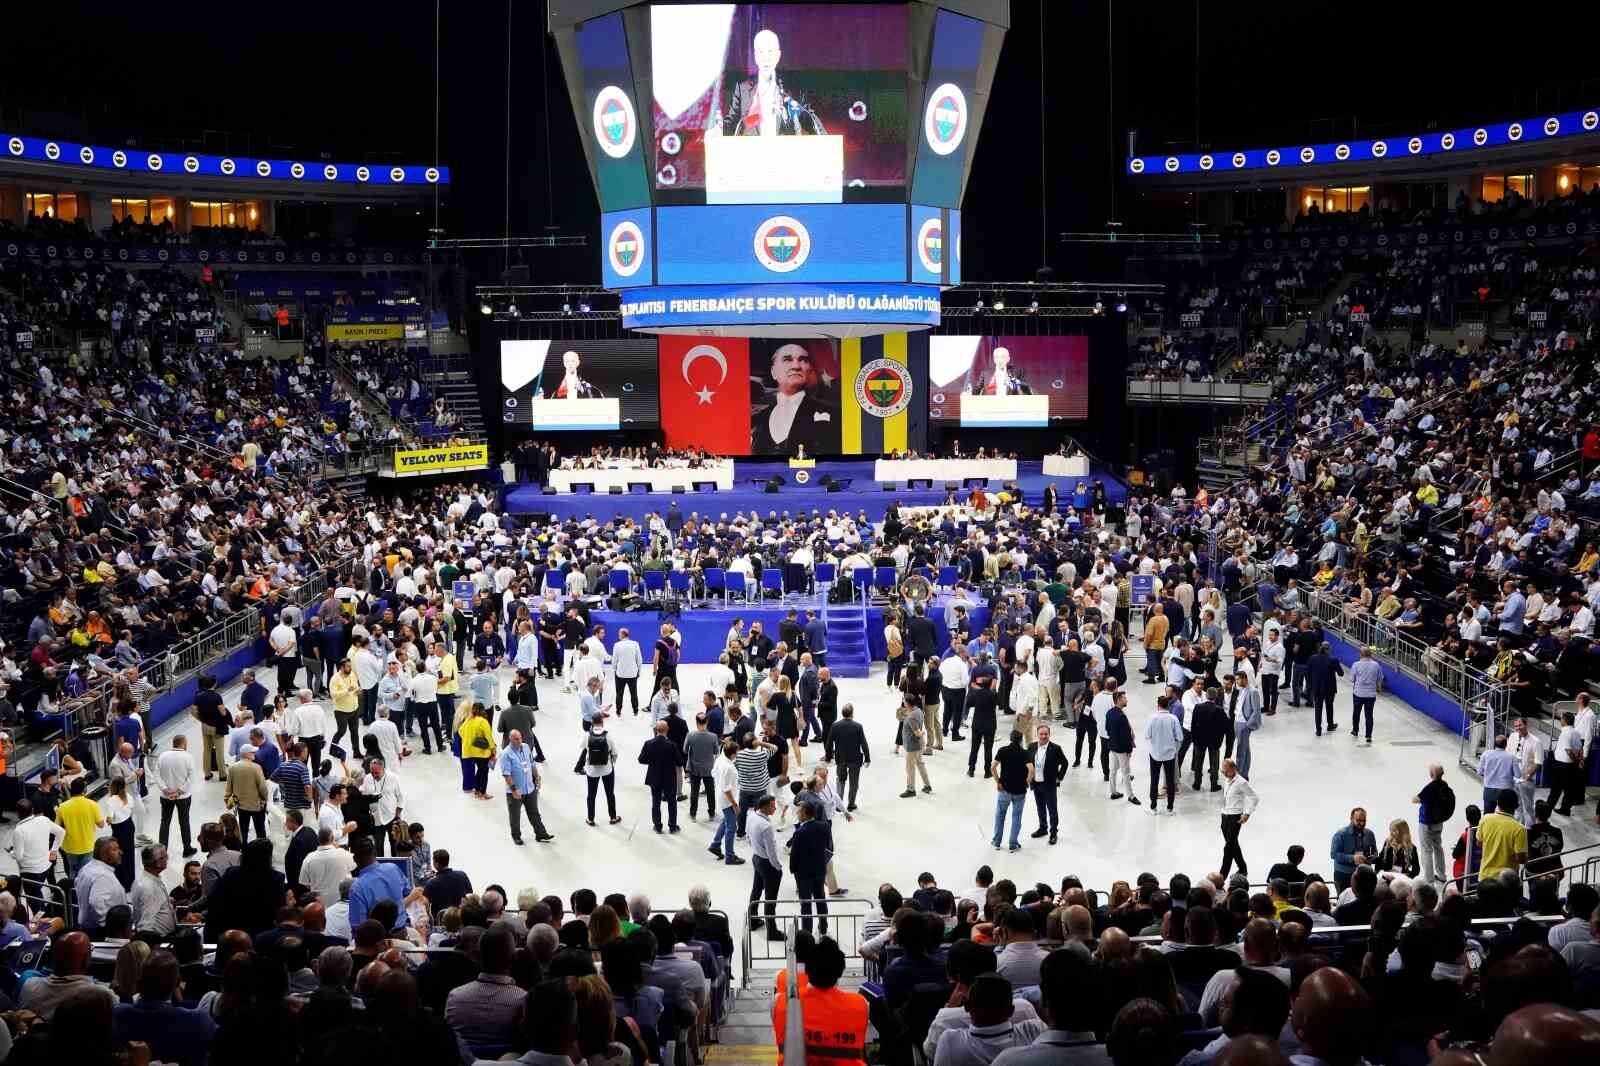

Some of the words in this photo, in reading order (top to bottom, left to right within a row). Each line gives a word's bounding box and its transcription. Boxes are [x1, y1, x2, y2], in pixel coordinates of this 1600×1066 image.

[670, 298, 754, 313] FENERBAHÇE
[756, 297, 796, 311] SPOR
[800, 294, 855, 310] KULÜBÜ
[858, 294, 923, 312] OLAĞANÜSTÜ
[401, 453, 447, 466] YELLOW
[449, 450, 483, 462] SEATS
